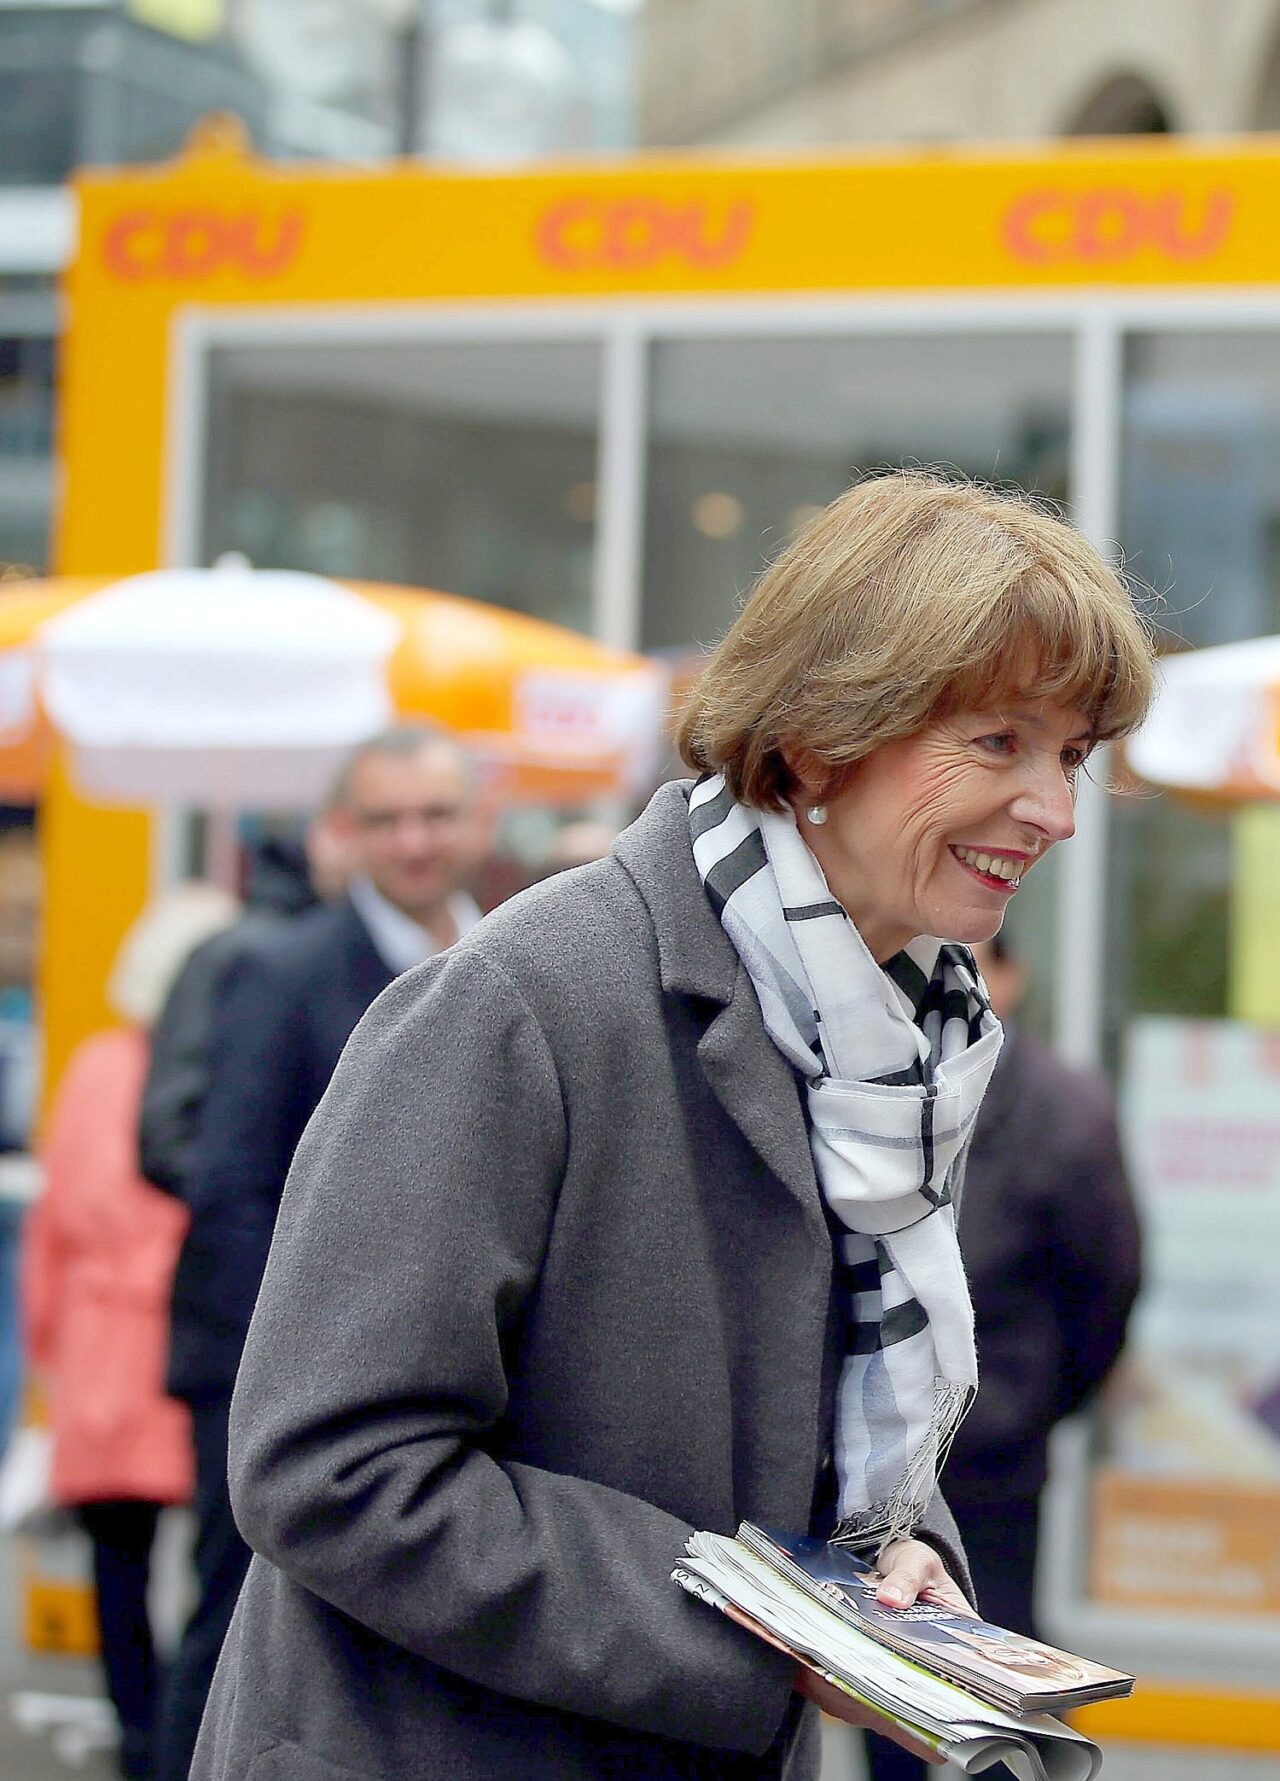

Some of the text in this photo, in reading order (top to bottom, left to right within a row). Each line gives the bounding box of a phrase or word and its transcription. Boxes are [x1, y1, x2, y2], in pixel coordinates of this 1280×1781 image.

[102, 207, 305, 280] CDU
[535, 197, 752, 270] CDU
[1002, 189, 1233, 265] CDU
